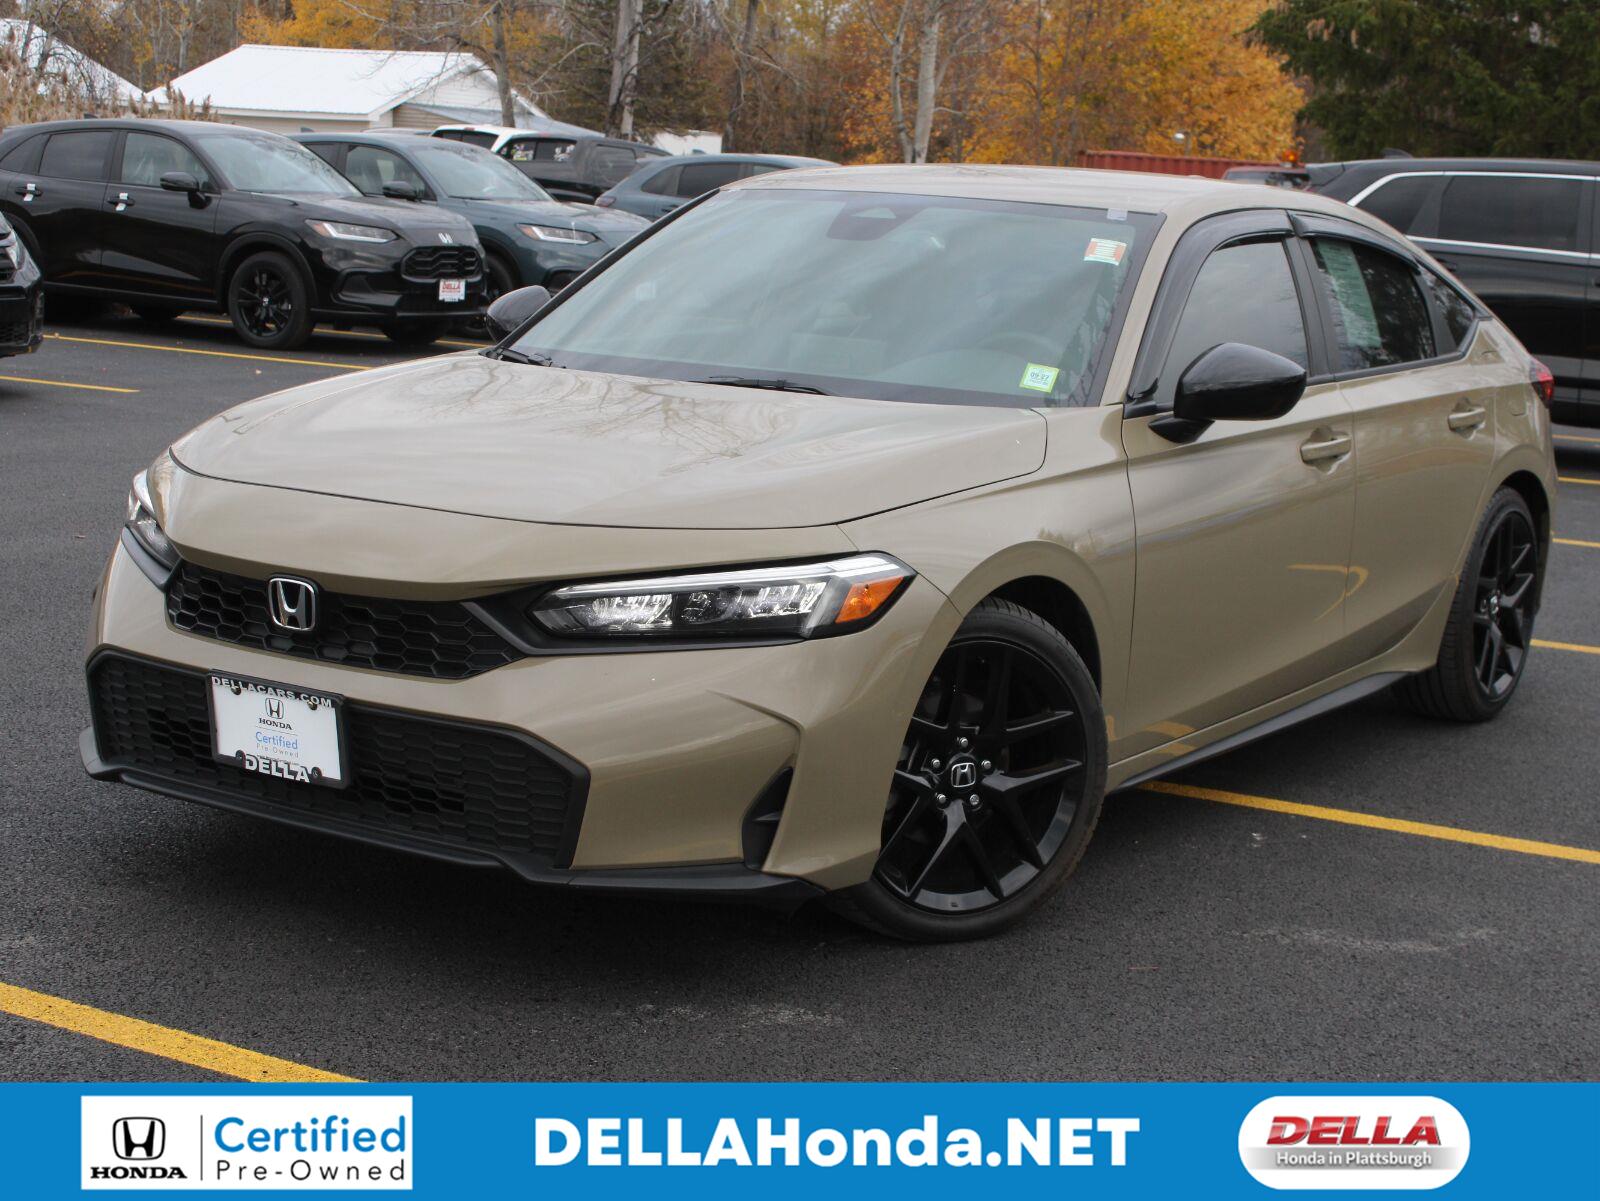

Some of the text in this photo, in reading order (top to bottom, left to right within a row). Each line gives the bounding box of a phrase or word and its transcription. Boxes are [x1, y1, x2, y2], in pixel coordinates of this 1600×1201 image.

[212, 676, 332, 708] DELLACARS.COM
[259, 718, 293, 730] HONDA
[256, 732, 298, 749] Certified
[245, 755, 310, 783] DELLA
